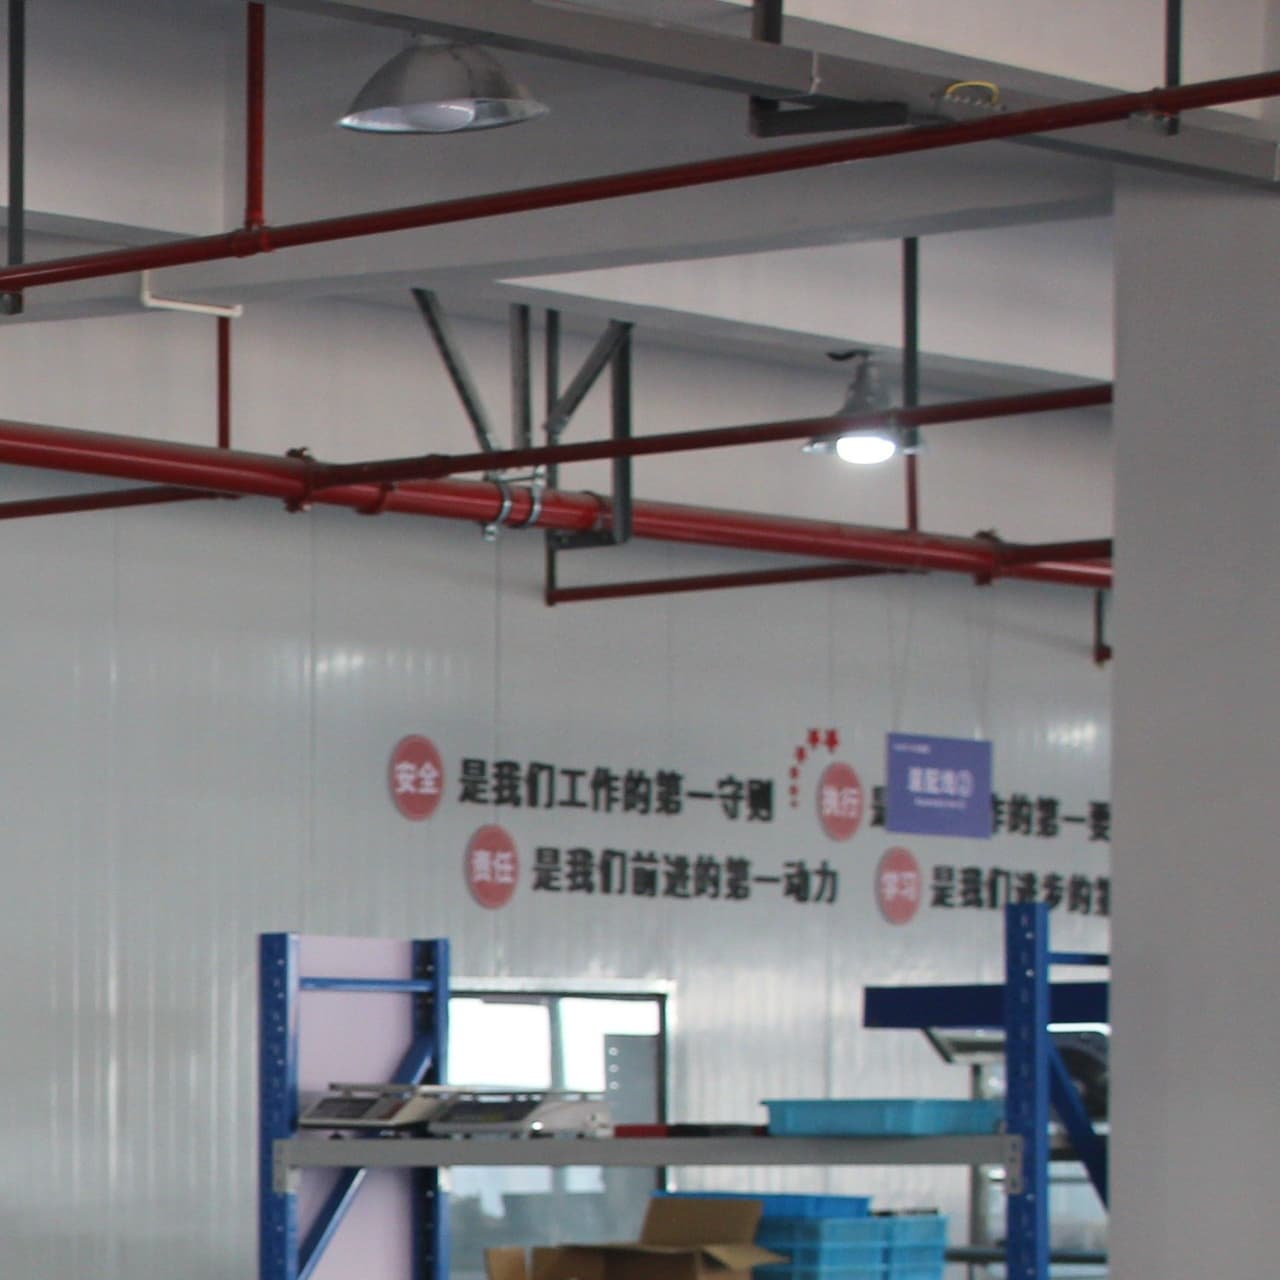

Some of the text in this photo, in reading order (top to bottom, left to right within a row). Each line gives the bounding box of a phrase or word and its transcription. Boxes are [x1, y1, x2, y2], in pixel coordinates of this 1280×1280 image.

[394, 761, 439, 794] 安全
[458, 757, 773, 822] 是我们工作的第一守则
[532, 847, 838, 904] 是我们前进的第一动力
